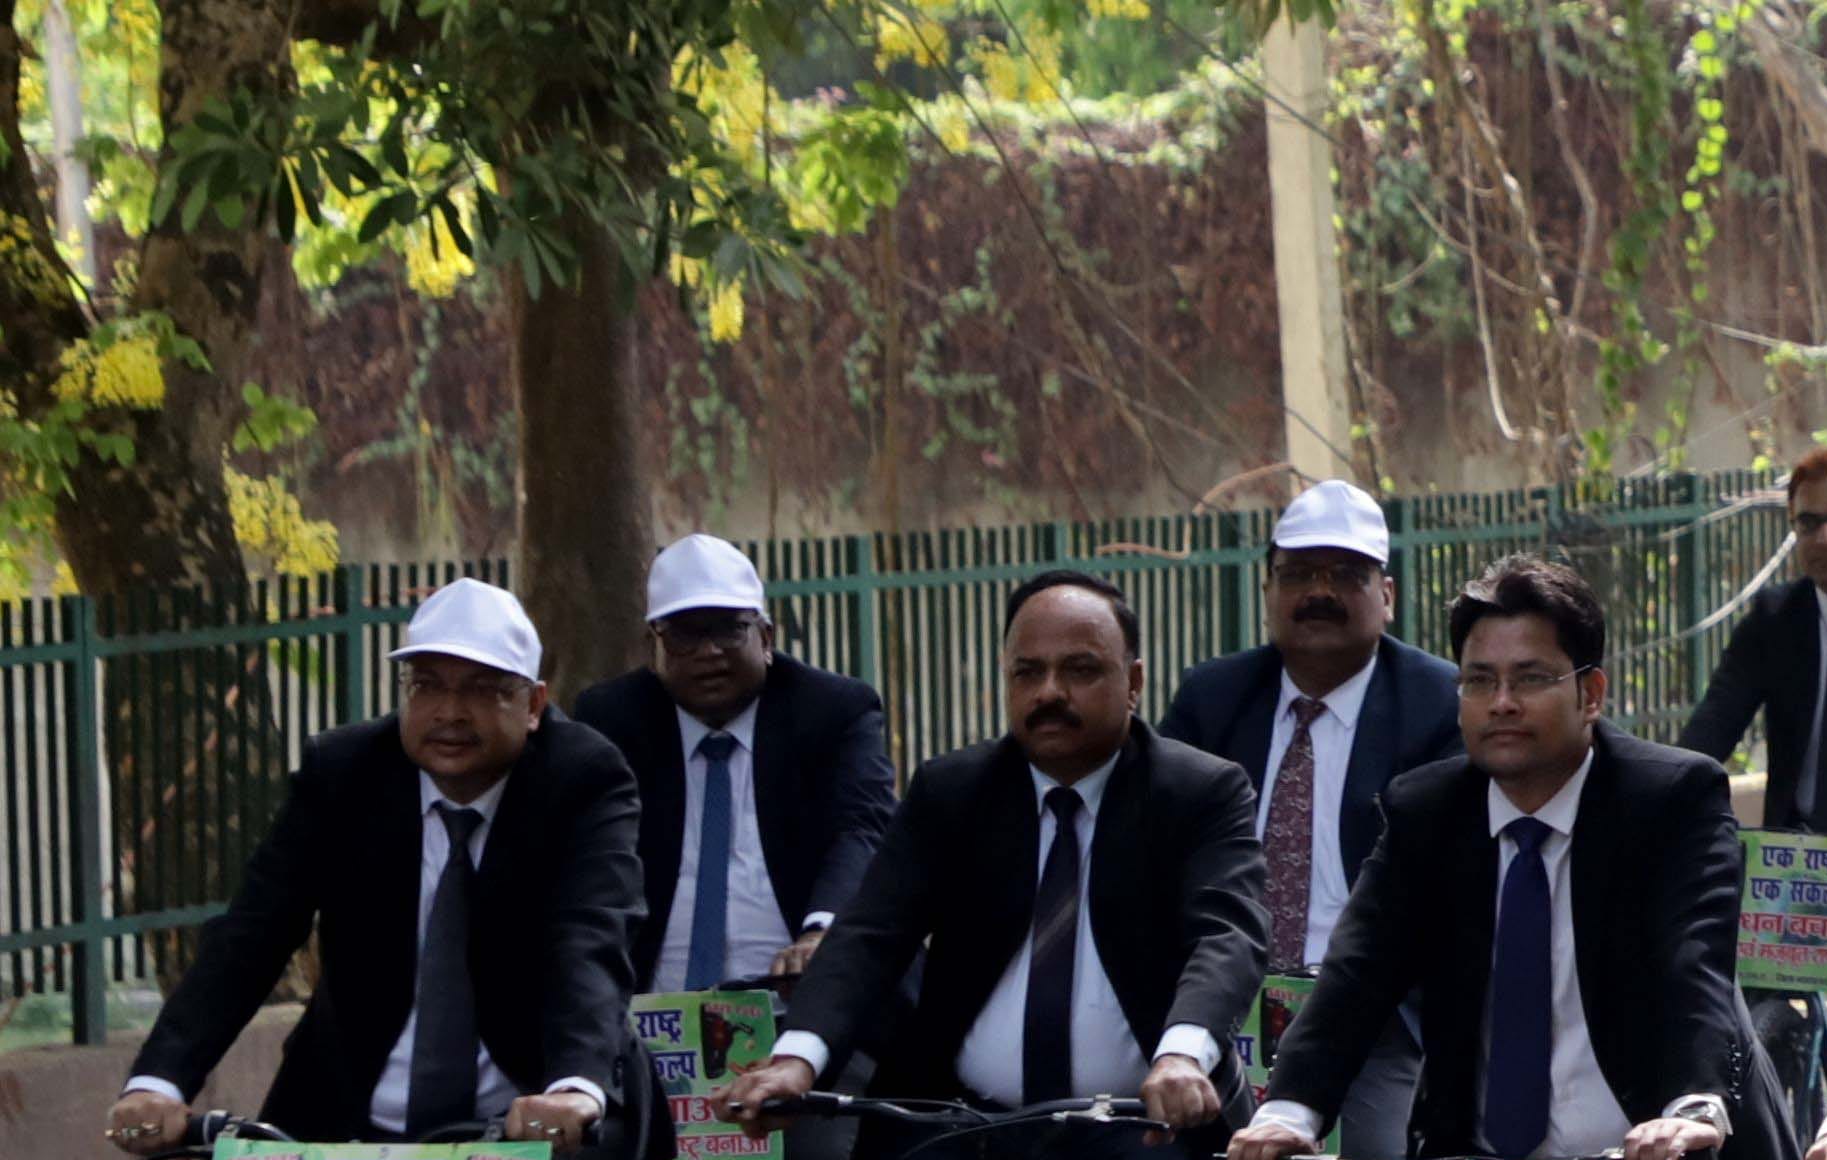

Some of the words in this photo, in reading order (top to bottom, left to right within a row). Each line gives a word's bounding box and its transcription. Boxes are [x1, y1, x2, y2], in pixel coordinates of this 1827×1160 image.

[1761, 846, 1796, 868] एक
[1751, 878, 1782, 898] एक
[634, 1010, 682, 1043] राष्ट्र
